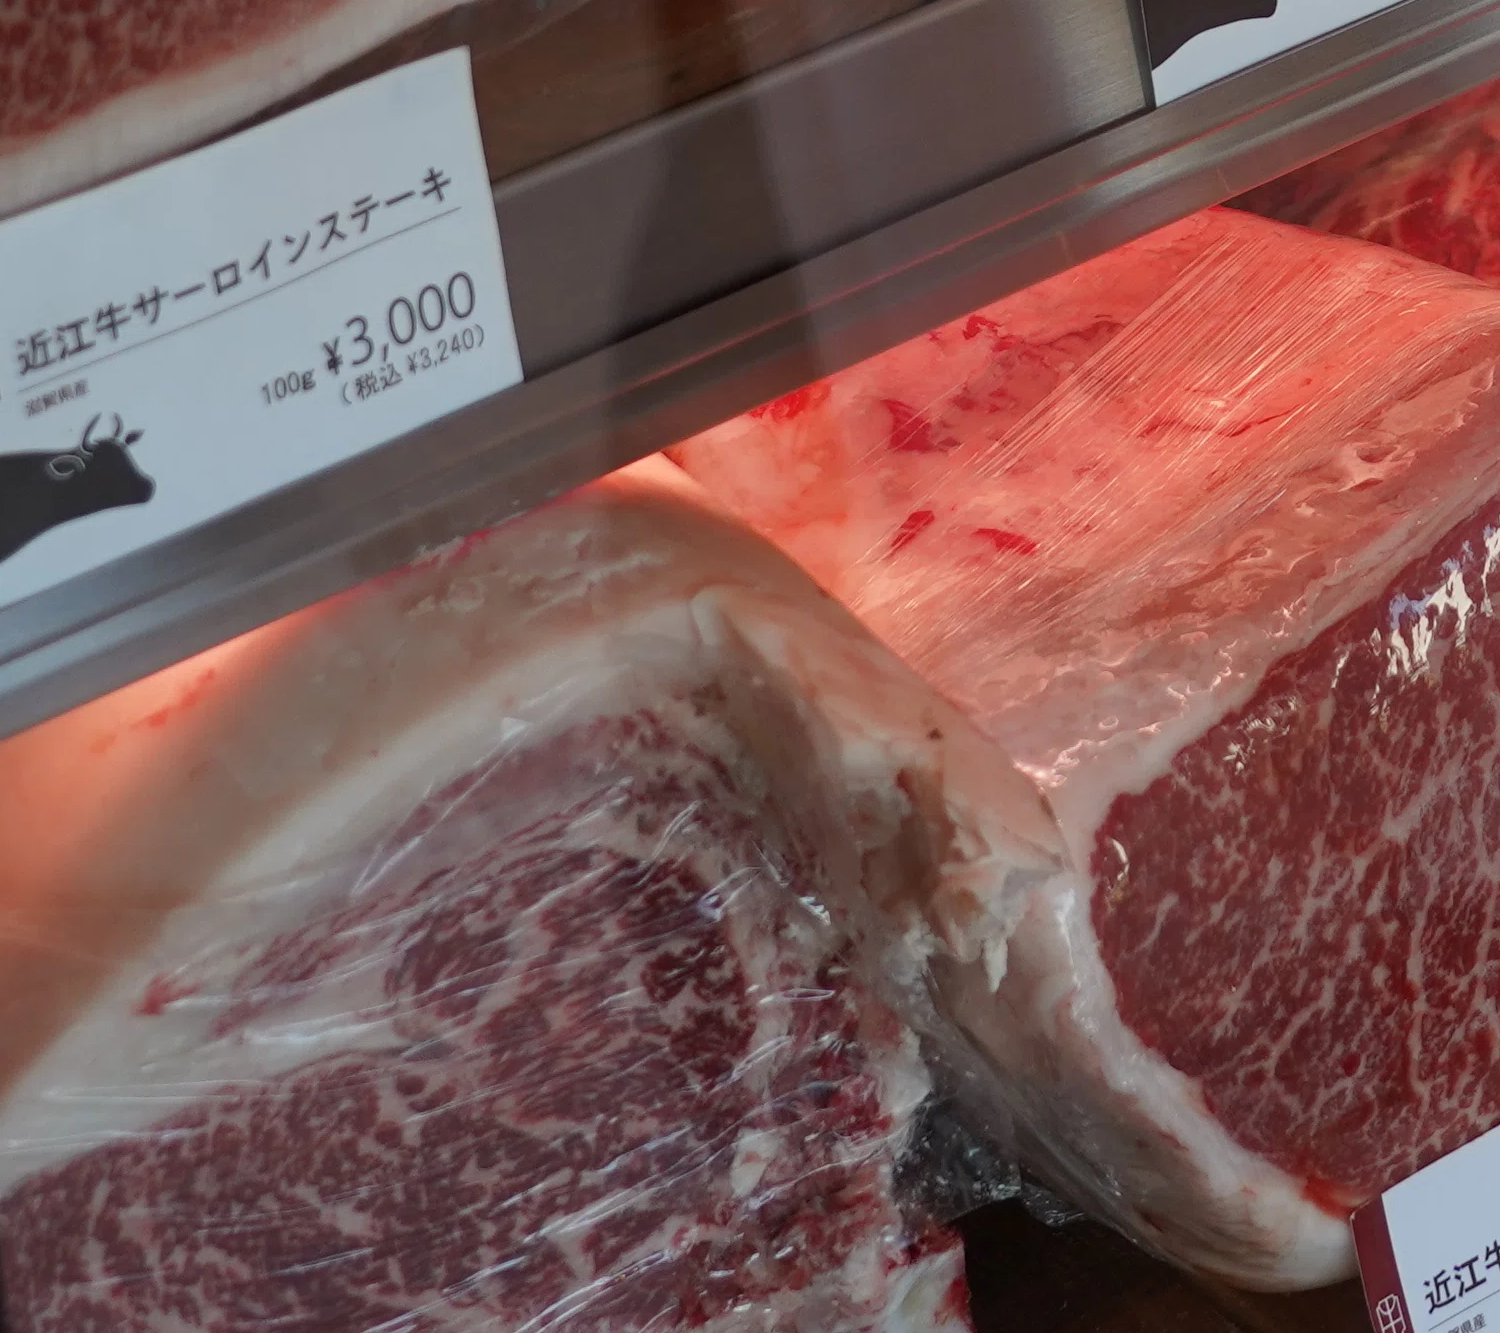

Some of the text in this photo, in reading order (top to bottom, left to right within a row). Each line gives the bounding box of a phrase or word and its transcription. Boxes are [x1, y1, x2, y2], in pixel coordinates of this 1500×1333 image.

[16, 165, 452, 377] 近江牛サーロインステーキ
[261, 271, 476, 406] 100g ¥3,000
[340, 324, 485, 406] (税込 ¥3,240)
